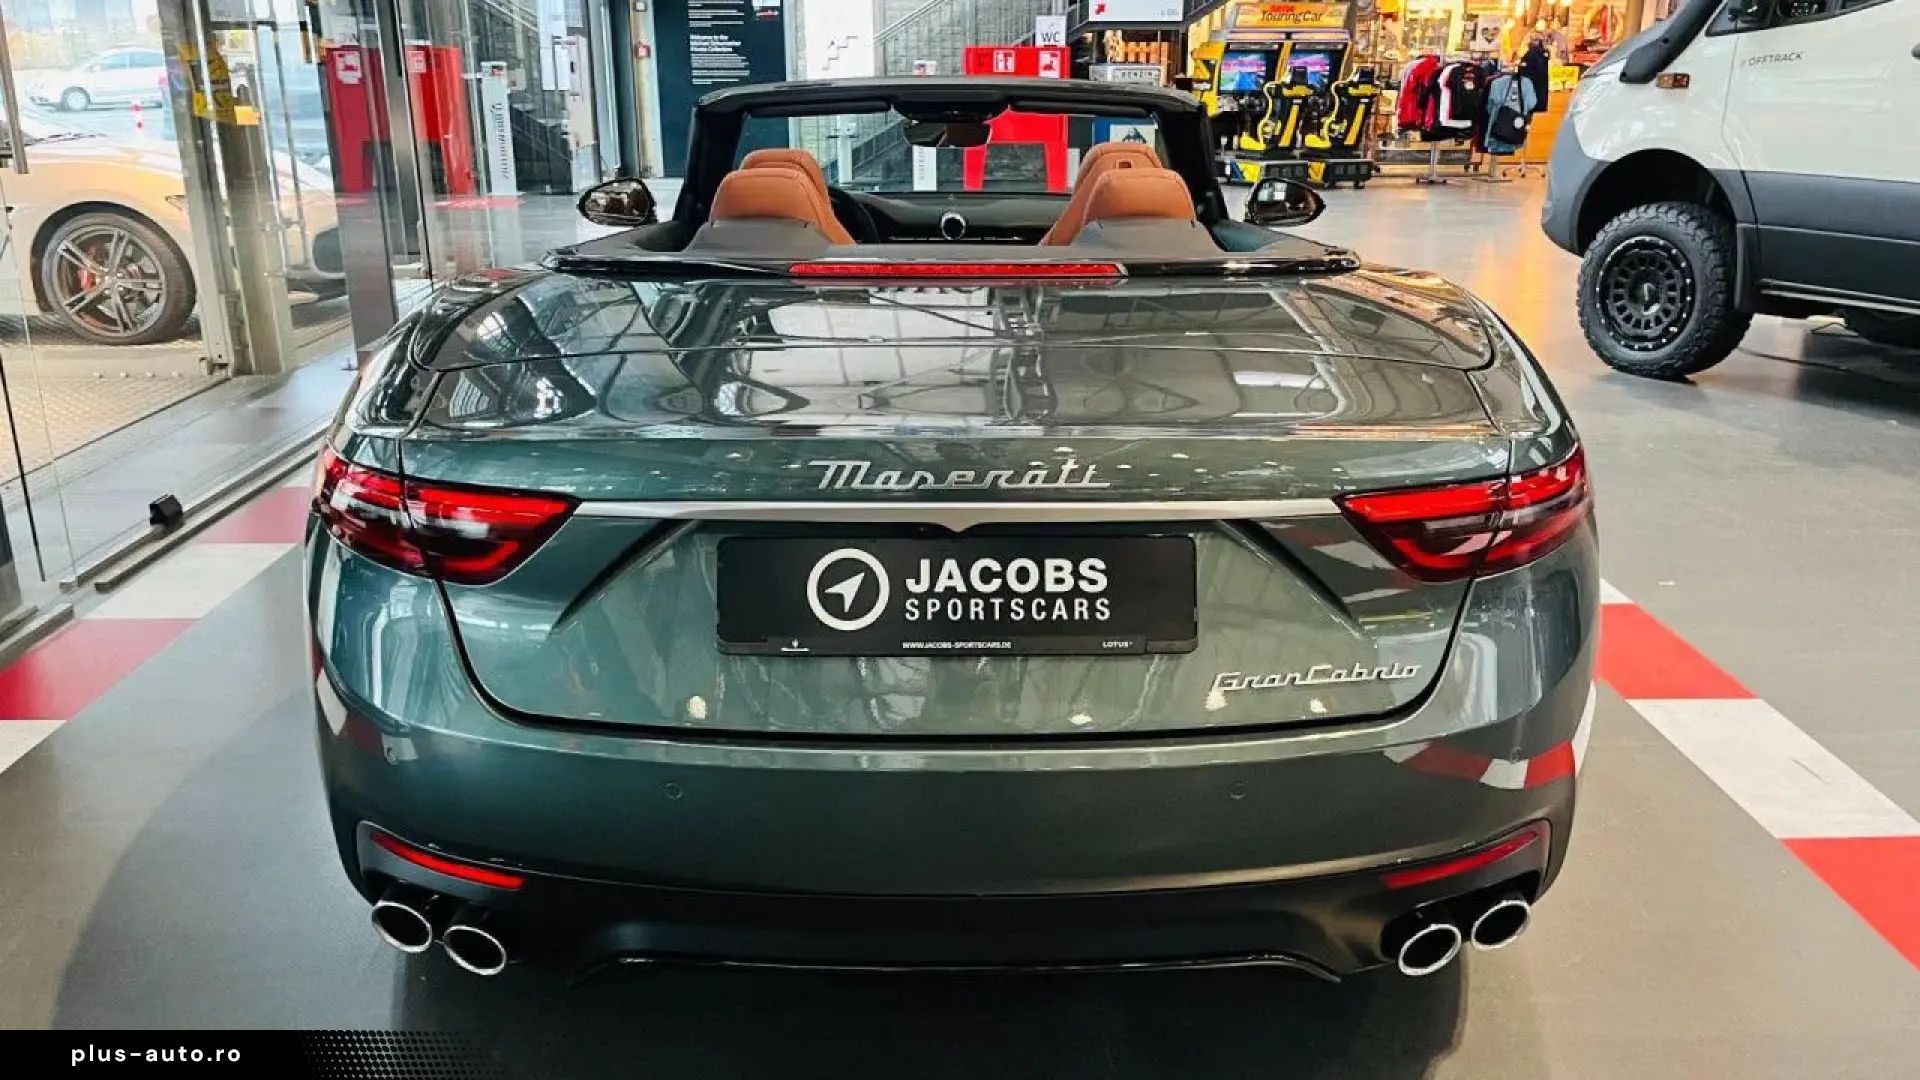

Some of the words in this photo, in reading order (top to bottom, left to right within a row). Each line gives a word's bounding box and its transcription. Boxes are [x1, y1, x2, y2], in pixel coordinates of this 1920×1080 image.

[1040, 31, 1061, 43] WC
[1748, 52, 1804, 67] OFFTRACK
[808, 458, 1111, 490] Maserati
[905, 557, 1108, 594] JACOBS
[904, 597, 1111, 622] SPORTSCARS
[902, 641, 1012, 649] WWW.JACOBS-SPORTSCARS.DE
[1211, 662, 1422, 691] GranCabrio
